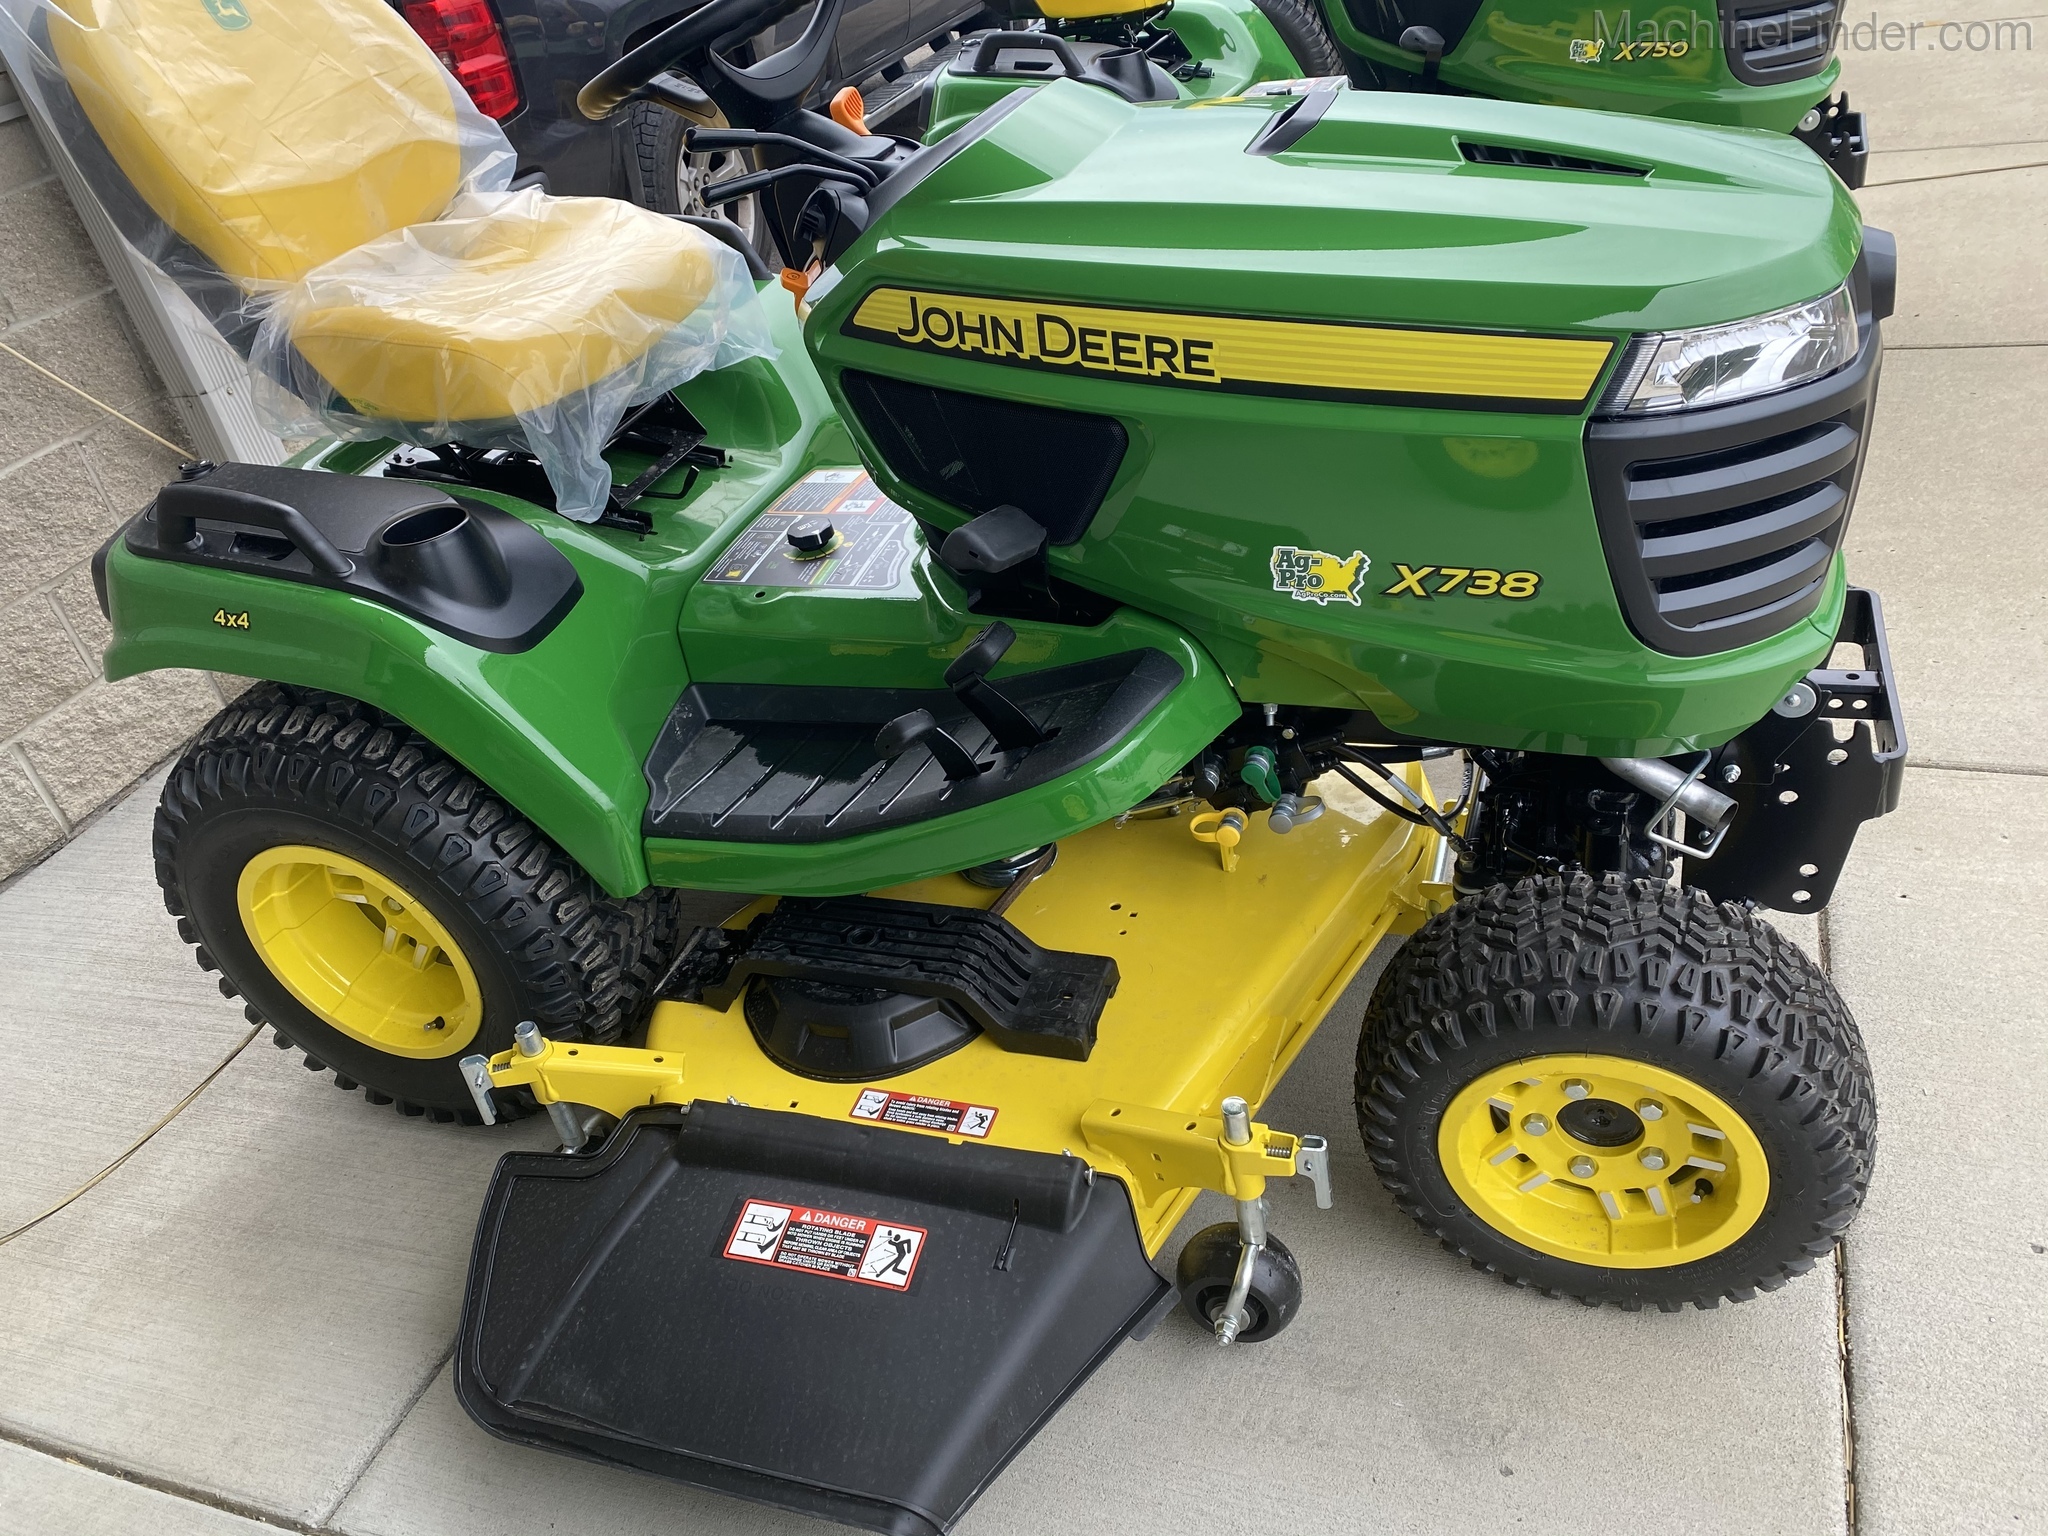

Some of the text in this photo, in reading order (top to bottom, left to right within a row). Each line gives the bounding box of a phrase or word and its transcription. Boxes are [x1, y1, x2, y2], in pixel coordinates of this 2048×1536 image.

[1612, 41, 1690, 61] X750
[897, 296, 1217, 378] JOHN DEERE
[1277, 568, 1324, 589] Pro
[1381, 563, 1542, 600] X738
[212, 608, 250, 630] 4x4
[916, 1096, 951, 1107] DANGER
[801, 1224, 833, 1233] ROTATING
[813, 1212, 867, 1231] DANGER
[794, 1237, 853, 1250] THROWN OBJECTS
